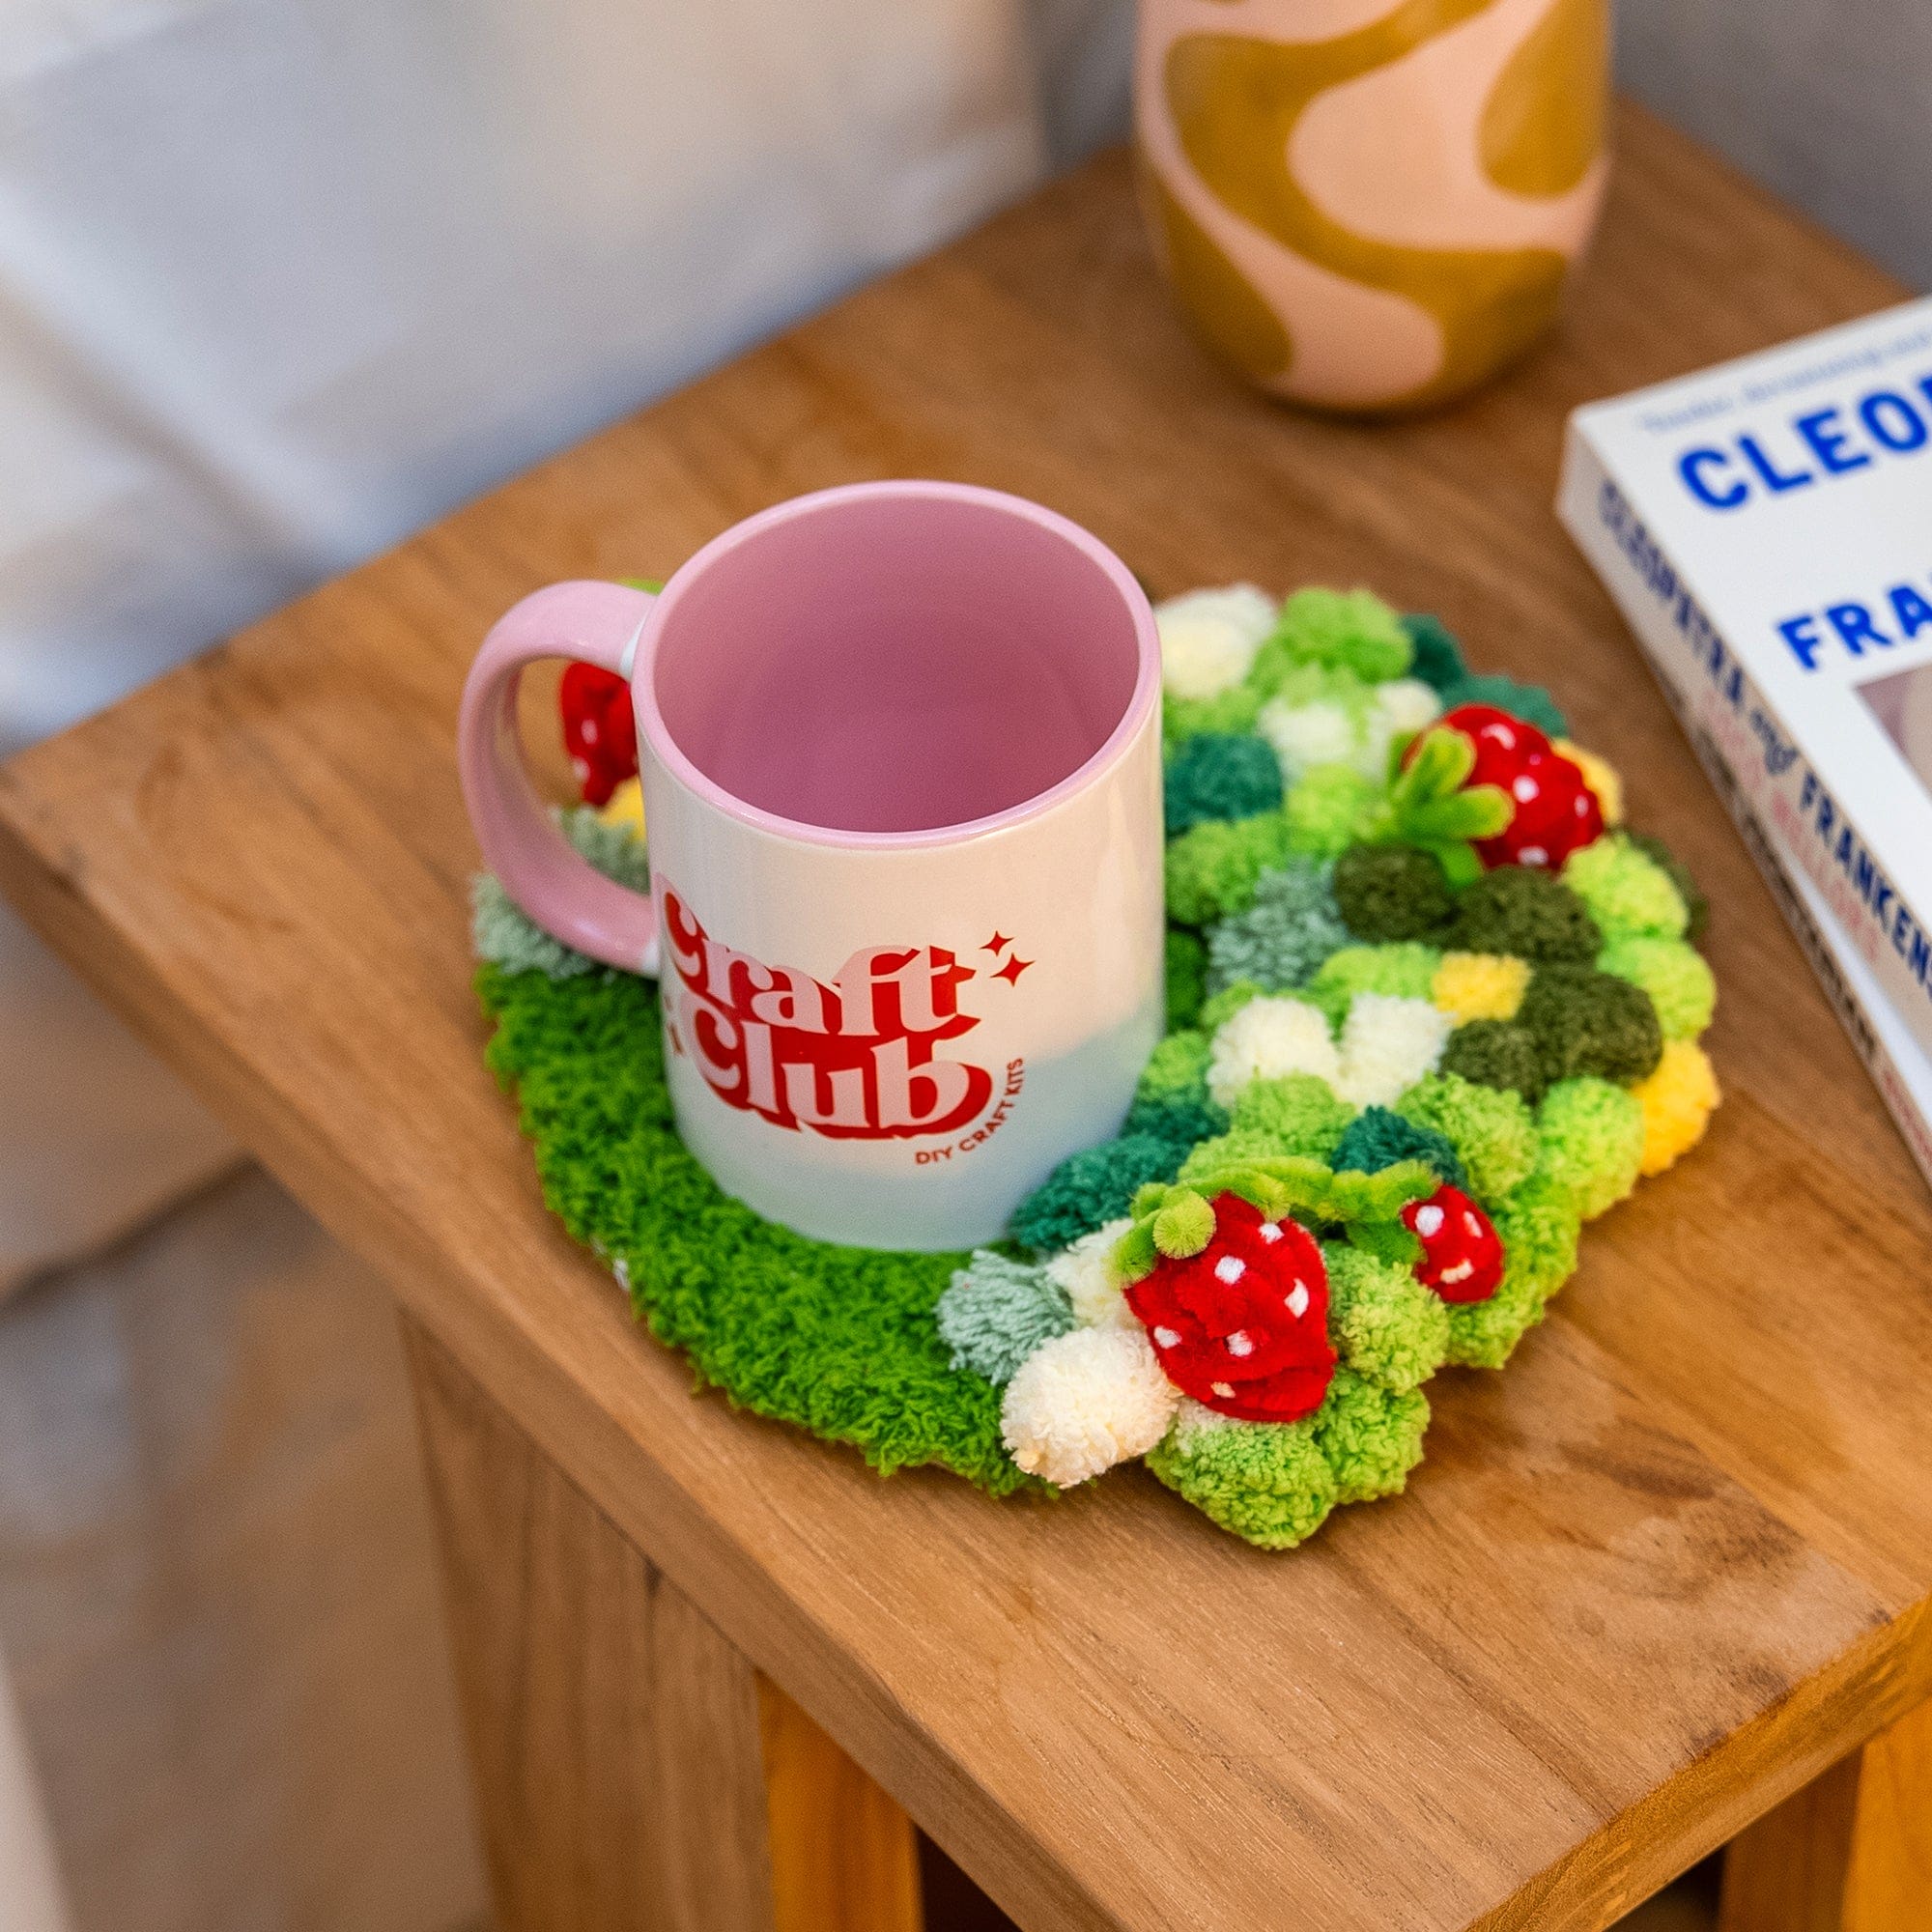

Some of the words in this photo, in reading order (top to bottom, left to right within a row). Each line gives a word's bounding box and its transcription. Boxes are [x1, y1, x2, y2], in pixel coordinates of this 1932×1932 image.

[1678, 376, 1932, 510] CLEO
[651, 872, 981, 1041] Craft
[680, 991, 993, 1141] Club
[914, 1145, 952, 1165] DIY
[958, 1098, 1014, 1151] CRAFT
[1004, 1058, 1024, 1096] KITS
